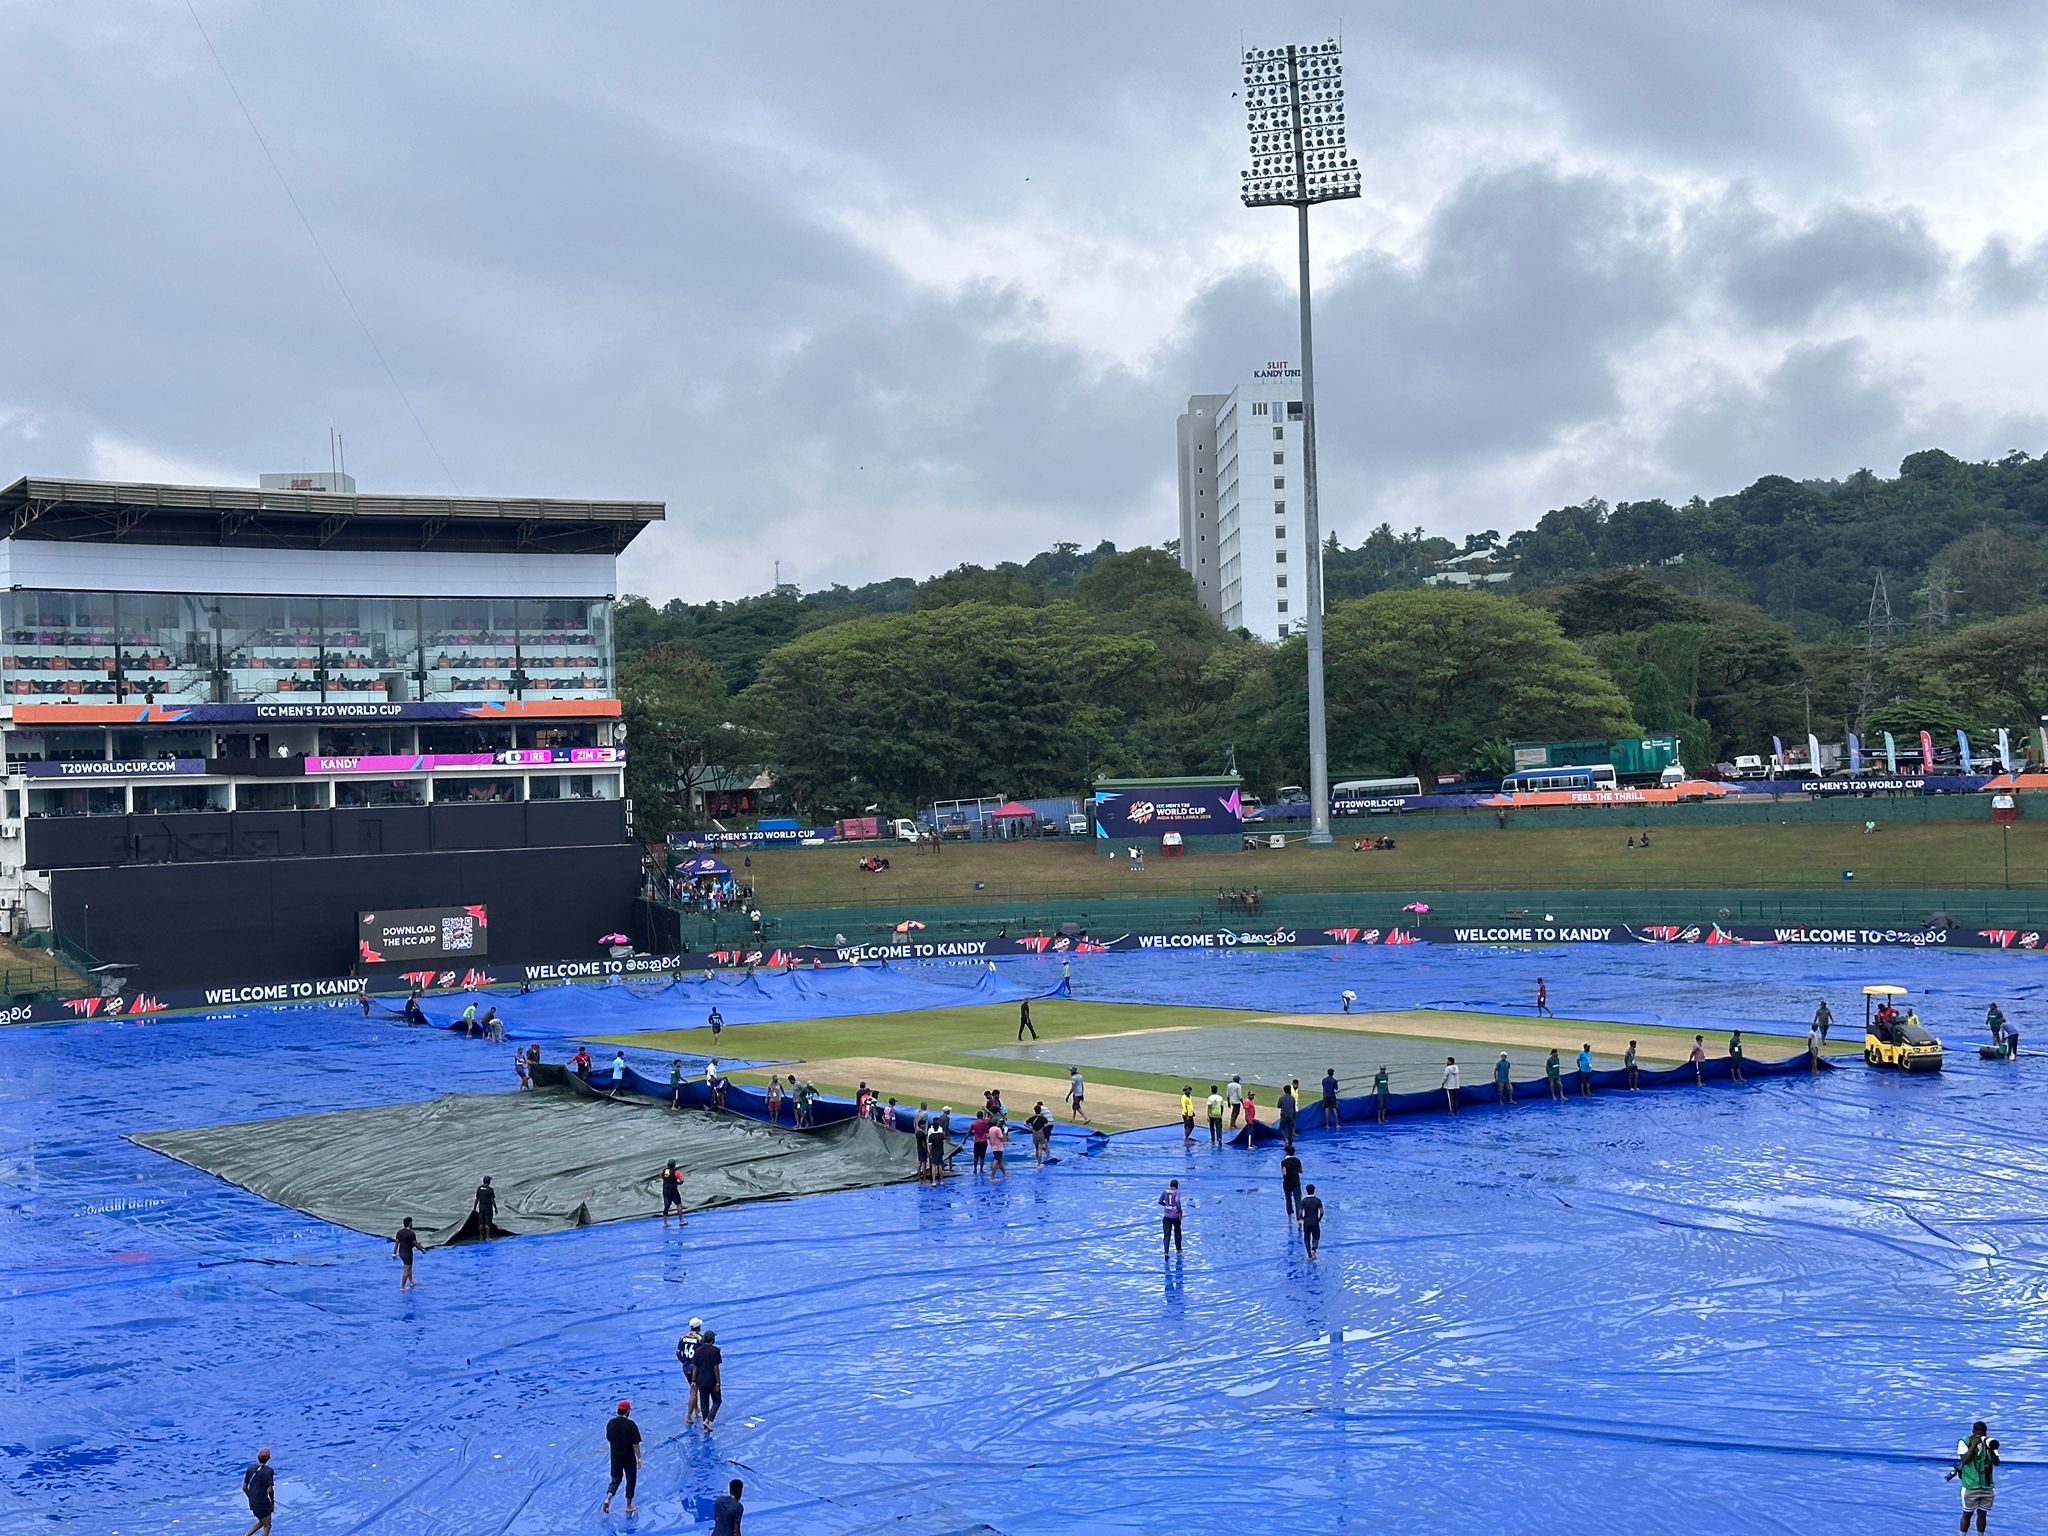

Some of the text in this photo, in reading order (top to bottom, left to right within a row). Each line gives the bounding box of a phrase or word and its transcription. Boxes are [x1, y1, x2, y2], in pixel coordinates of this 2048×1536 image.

[1267, 361, 1288, 369] SLIIT
[1253, 369, 1301, 378] KANDY UNI
[257, 705, 402, 717] ICC MEN'S T20 WORLD CUP
[529, 752, 545, 761] IRE
[577, 751, 594, 760] ZIM
[60, 761, 176, 775] T20WORLDCUP.COM
[320, 759, 358, 769] KANDY
[1801, 780, 1925, 791] ICC MEN'S T20 WORLD CUP
[1572, 792, 1645, 801] FEEL THE THRILL
[1334, 799, 1406, 808] #T20WORLDCUP
[1189, 807, 1206, 815] CUP
[720, 832, 747, 841] MEN'S
[748, 832, 764, 840] T20
[765, 830, 797, 839] WORLD
[798, 830, 815, 838] CUP
[382, 925, 436, 936] DOWNLOAD
[1454, 927, 1611, 941] WELCOME TO KANDY
[1775, 929, 1856, 943] WELCOME
[1859, 930, 1881, 943] TO
[383, 936, 437, 947] THE ICC APP
[1139, 934, 1213, 948] WELCOME
[1216, 933, 1236, 947] TO
[837, 941, 987, 960] WELCOME TO KANDY
[525, 961, 600, 979] WELCOME
[603, 961, 622, 973] TO
[205, 978, 368, 1004] WELCOME TO KANDY
[684, 1343, 695, 1359] 46
